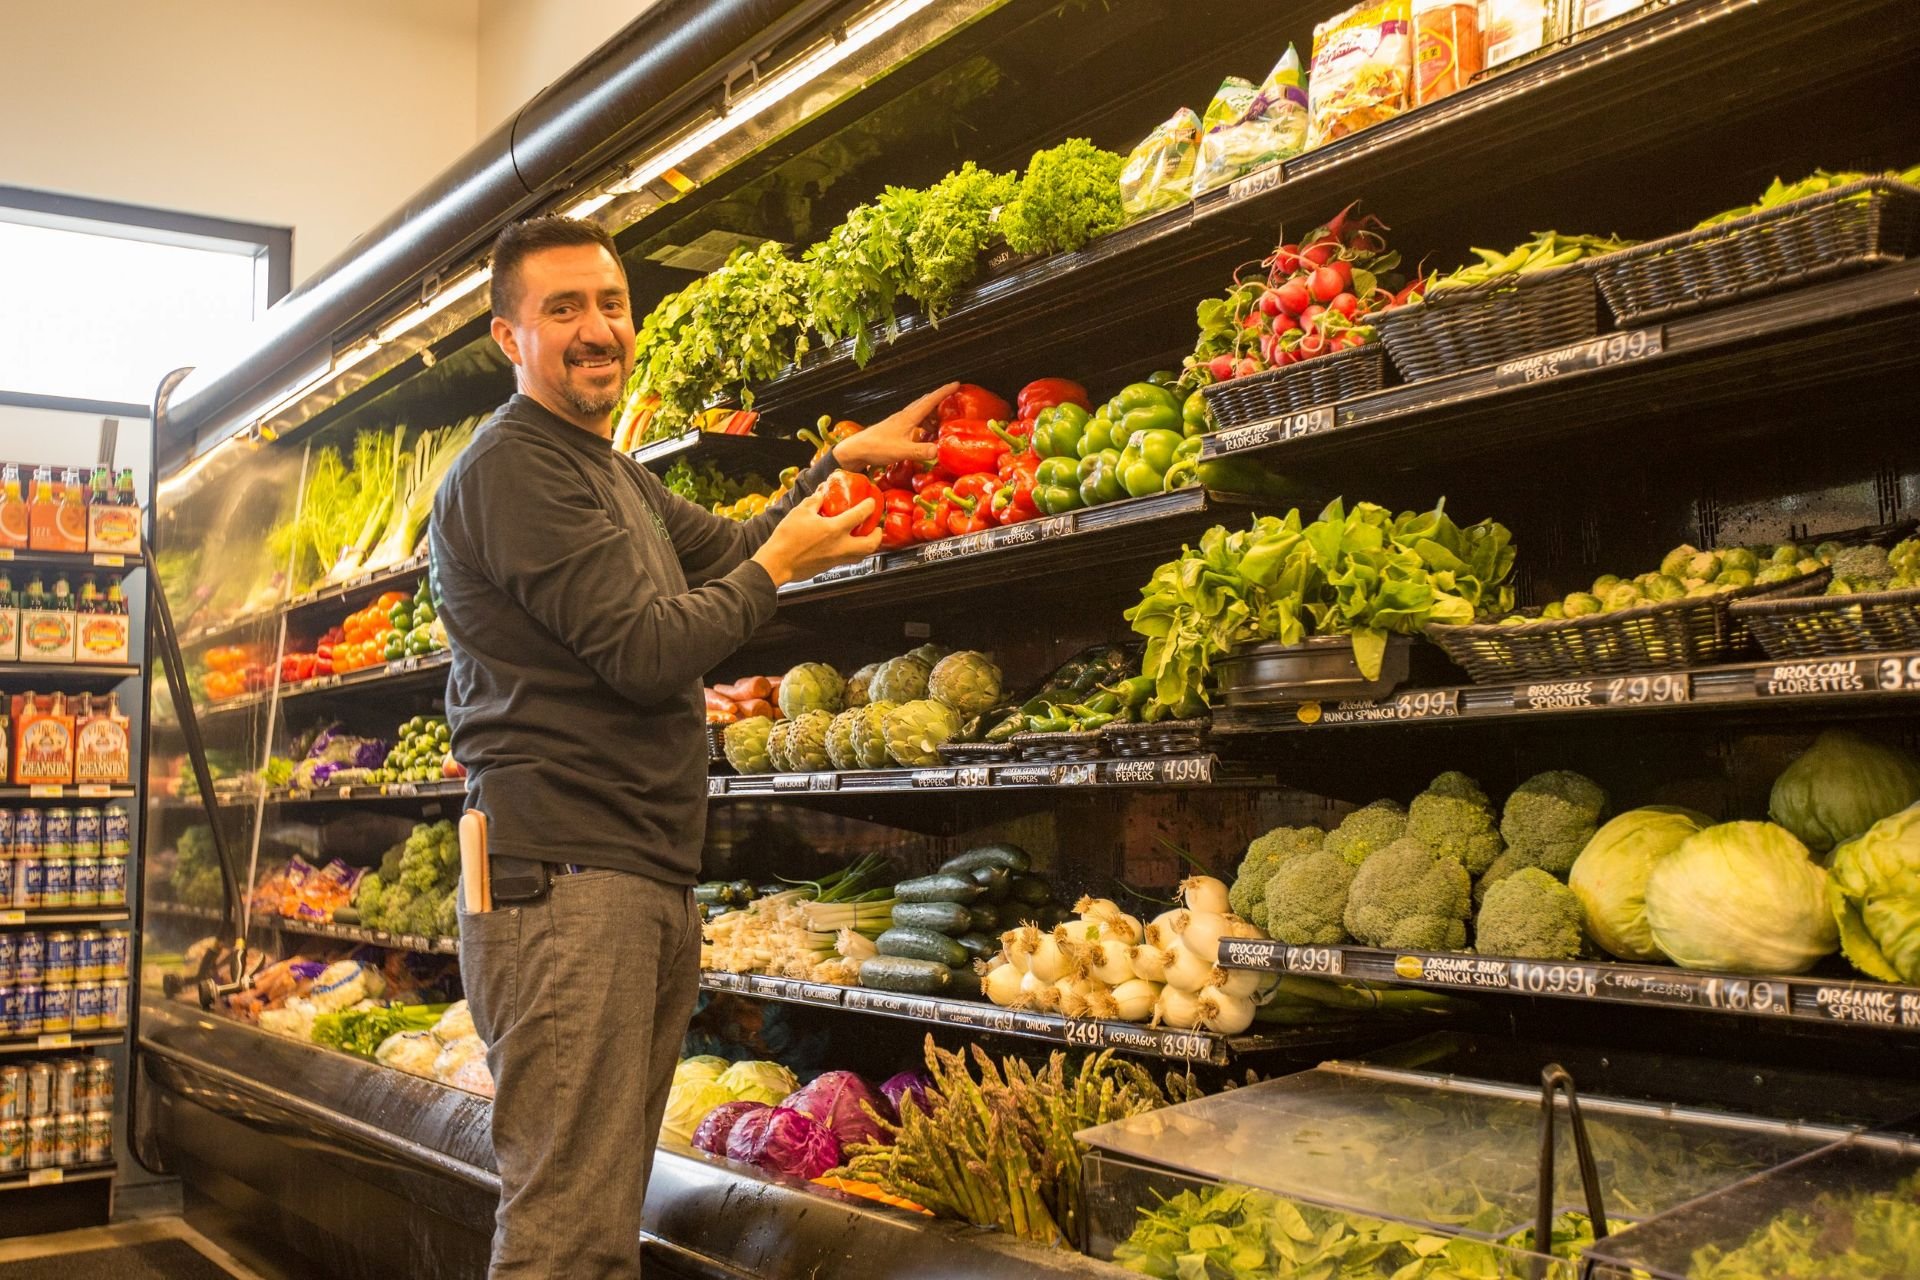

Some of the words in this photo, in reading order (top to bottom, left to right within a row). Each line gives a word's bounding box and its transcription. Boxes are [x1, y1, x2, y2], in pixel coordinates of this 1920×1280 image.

[1587, 330, 1646, 366] 4.99
[1502, 356, 1542, 375] SUGAR
[1548, 346, 1583, 364] SNAP
[1525, 364, 1559, 382] PEAS
[1222, 428, 1252, 442] BUNCH
[1253, 421, 1274, 434] RED
[1284, 410, 1322, 439] 1.99
[1225, 432, 1269, 450] RADISHES
[1002, 531, 1035, 545] PEPPERS
[1011, 525, 1027, 535] BELL
[924, 549, 953, 562] PEPPERS
[1773, 661, 1856, 680] BROCCOLI
[1527, 682, 1593, 697] BRUSSELS
[1768, 675, 1864, 695] FLORETTES
[1338, 700, 1378, 710] ORGANIC
[1529, 694, 1591, 709] SPROUTS
[1324, 710, 1353, 723] BUNCH
[1355, 708, 1395, 721] SPINACH
[1115, 761, 1155, 772] JALAPENO
[1164, 759, 1200, 781] 4.99
[918, 778, 948, 787] PEPPERS
[1011, 775, 1039, 783] PEPPERS
[1116, 771, 1154, 782] PEPPERS
[1228, 943, 1274, 956] BROCCOLI
[1231, 953, 1270, 967] CROWNS
[1287, 947, 1330, 971] 2.99
[1426, 957, 1475, 972] ORGANIC
[1477, 960, 1505, 975] BABY
[1424, 970, 1471, 985] SPINACH
[1473, 973, 1508, 987] SALAD
[1514, 963, 1585, 993] 10.99
[803, 988, 838, 1001] CUCUMBERS
[1705, 978, 1773, 1010] 1.69
[1816, 988, 1896, 1008] ORGANIC
[949, 1014, 973, 1025] CARROTS
[1828, 1004, 1896, 1023] SPRING
[1025, 1016, 1051, 1032] ONIONS
[1109, 1031, 1157, 1048] ASPARAGUS
